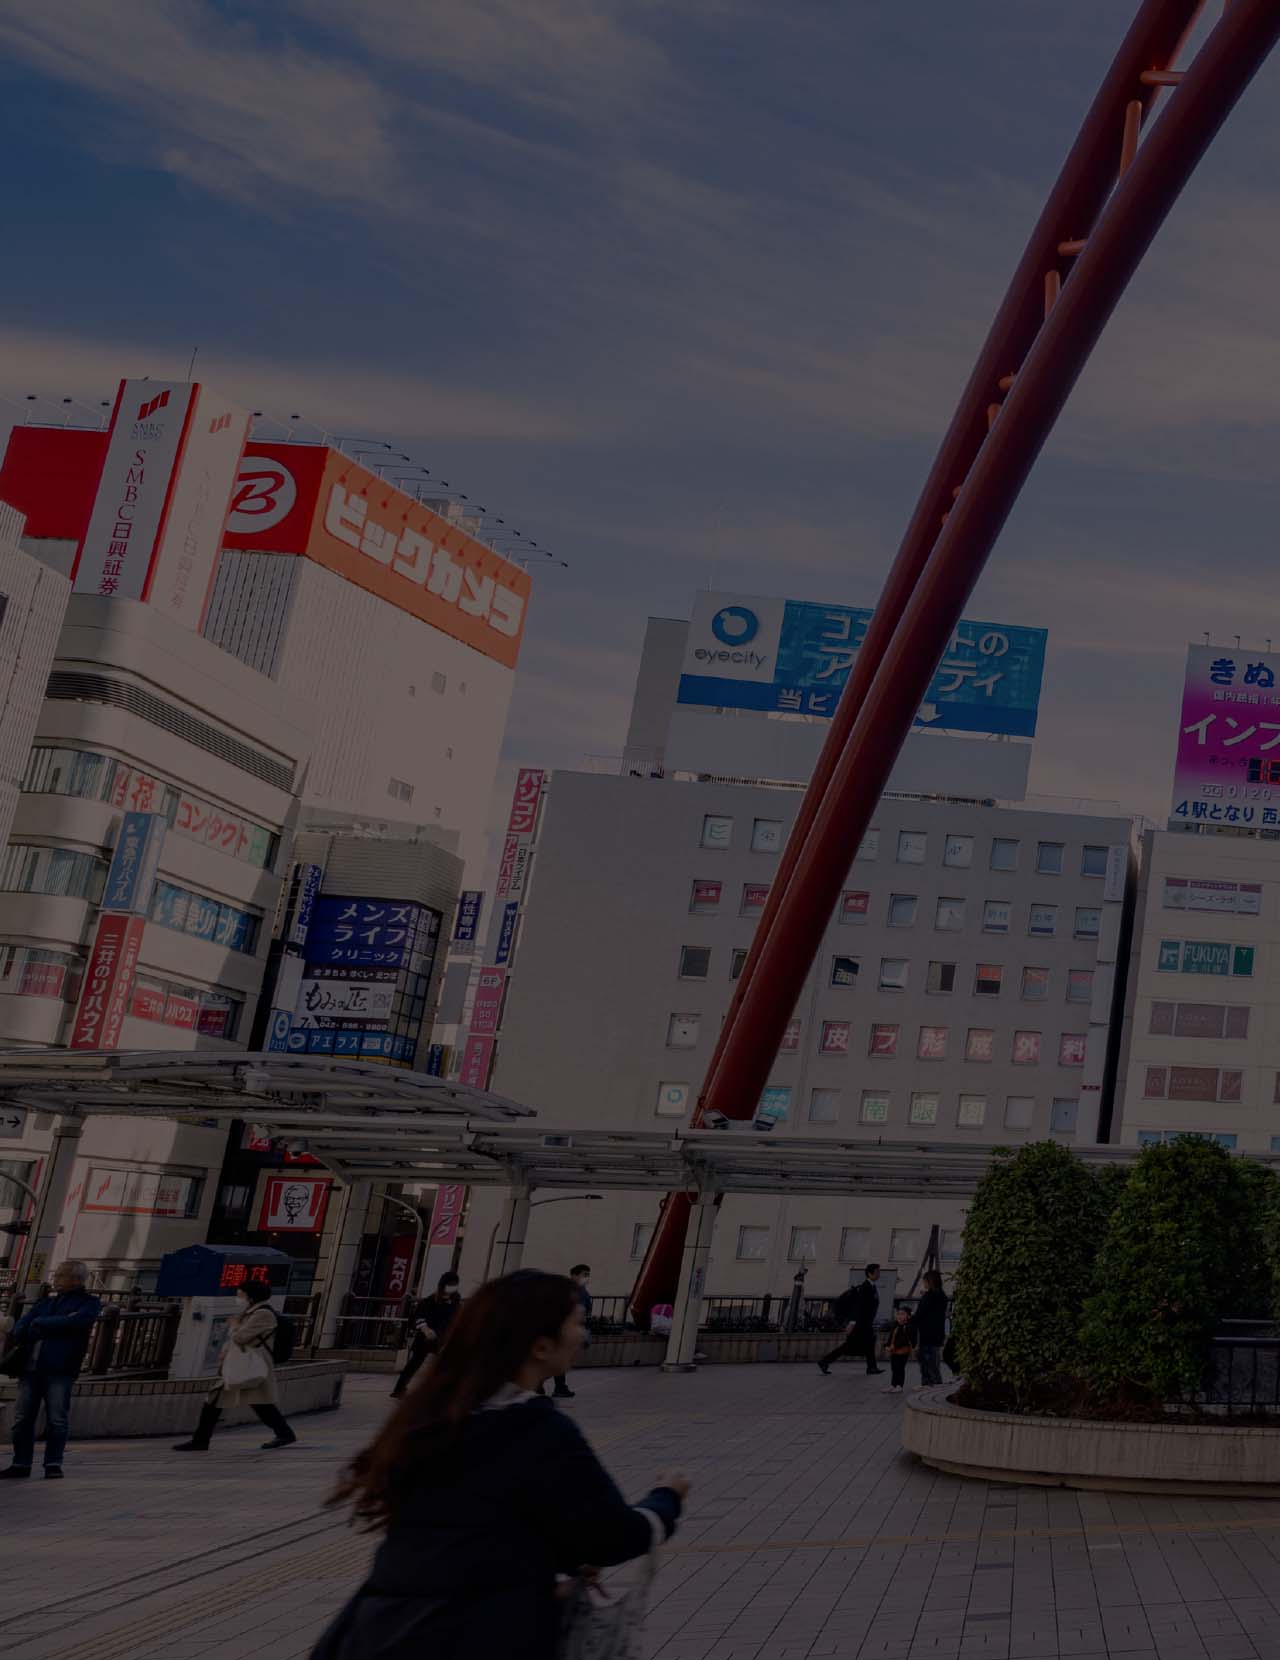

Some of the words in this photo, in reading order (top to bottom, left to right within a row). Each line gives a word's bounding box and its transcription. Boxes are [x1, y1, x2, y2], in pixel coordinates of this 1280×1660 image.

[97, 448, 147, 596] SMBC日興証券
[324, 482, 525, 638] ビックカメラ
[694, 647, 767, 670] eyecity
[511, 771, 542, 832] パソコン
[1175, 800, 1256, 823] 4駅となり
[175, 799, 249, 857] コンタクト
[337, 903, 412, 924] メンズ
[333, 924, 408, 945] ライフ
[330, 948, 401, 963] クリニック
[1184, 944, 1230, 963] FUKUYA
[77, 932, 122, 1044] 三井のリハウス
[388, 1256, 409, 1291] KFC
